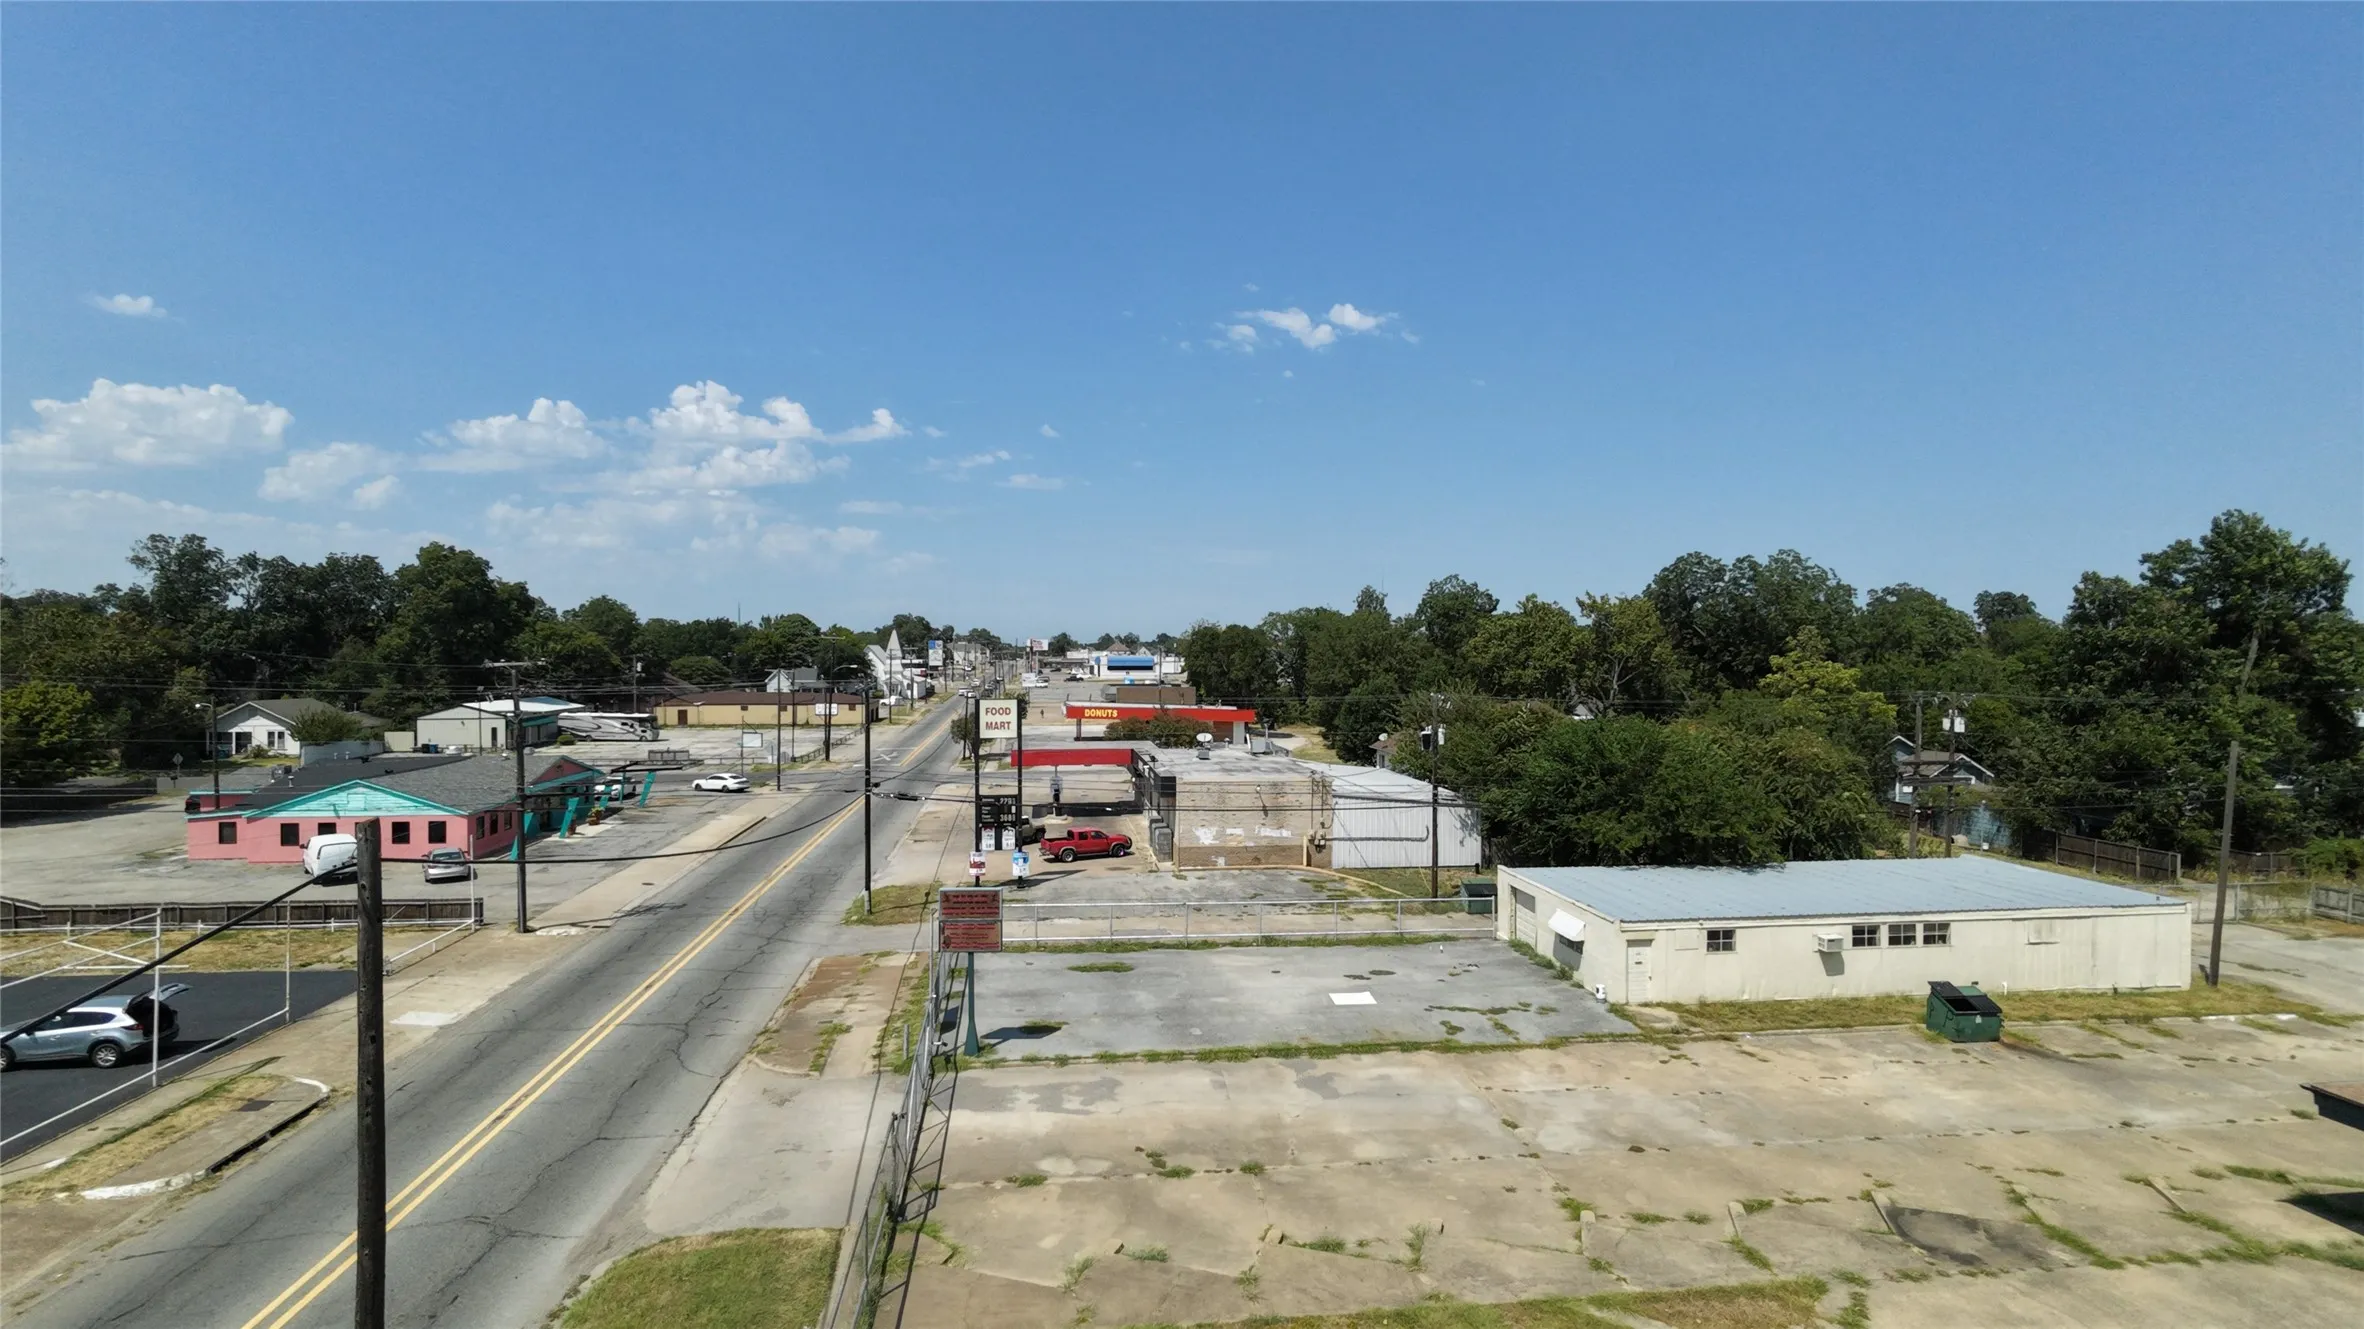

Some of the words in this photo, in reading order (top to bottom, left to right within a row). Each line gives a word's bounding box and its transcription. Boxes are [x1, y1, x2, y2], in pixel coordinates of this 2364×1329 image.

[985, 707, 1012, 716] FOOD
[1084, 708, 1119, 718] DONUTS
[985, 721, 1012, 731] MART
